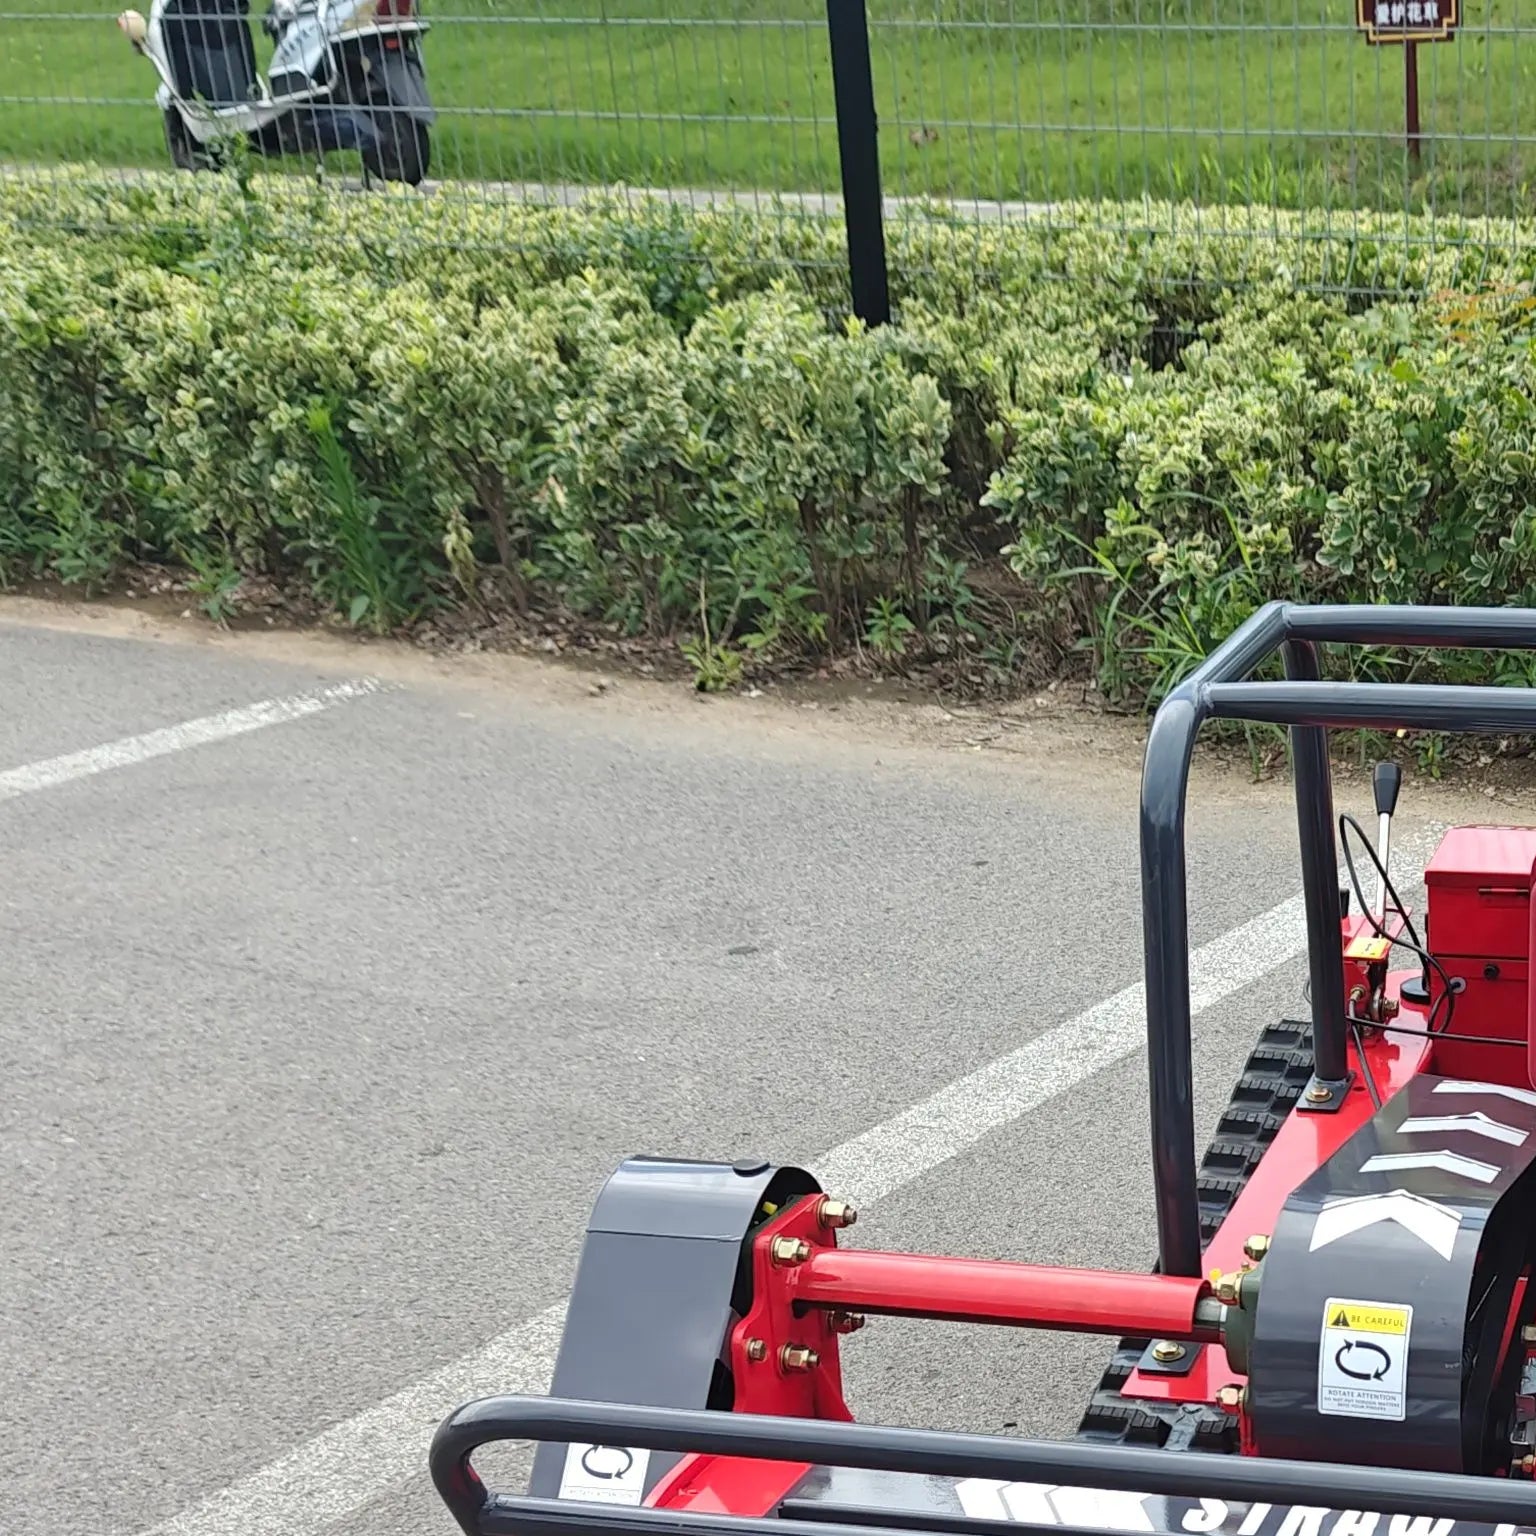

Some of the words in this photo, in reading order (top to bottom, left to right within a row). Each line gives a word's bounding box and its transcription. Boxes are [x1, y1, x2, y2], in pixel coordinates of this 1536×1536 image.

[1351, 1314, 1361, 1323] BE
[1365, 1316, 1404, 1327] CAREFUL
[1328, 1389, 1354, 1397] ROTATE
[1356, 1392, 1397, 1401] ATTENTION
